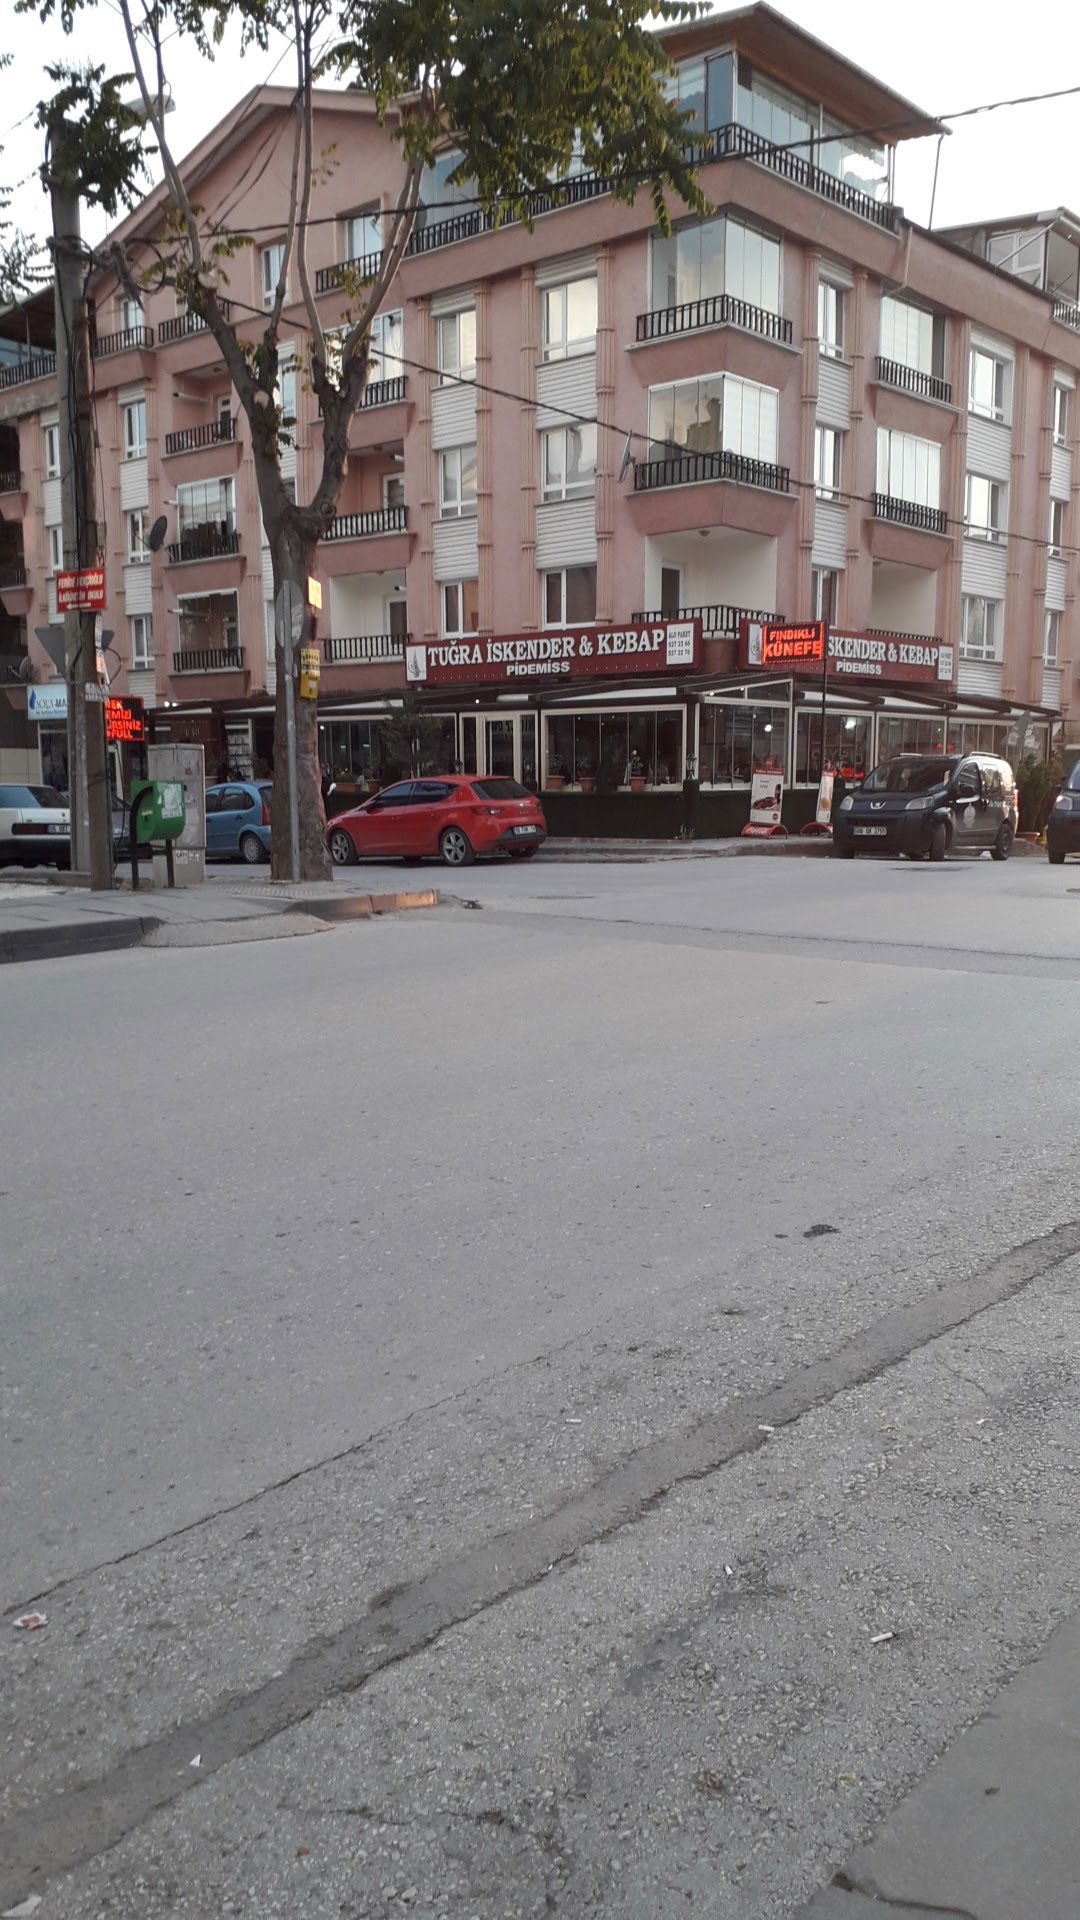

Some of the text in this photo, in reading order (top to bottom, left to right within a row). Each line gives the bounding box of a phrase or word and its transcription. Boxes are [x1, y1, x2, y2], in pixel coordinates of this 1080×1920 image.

[428, 628, 666, 666] TUĞRA İSKENDER & KEBAP
[765, 639, 821, 657] KÜNEFE
[828, 635, 886, 663] SKENDER
[888, 645, 897, 663] &
[899, 644, 939, 666] KEBAP
[506, 660, 571, 676] PİDEMİSS
[836, 660, 883, 675] PİDEMİSS
